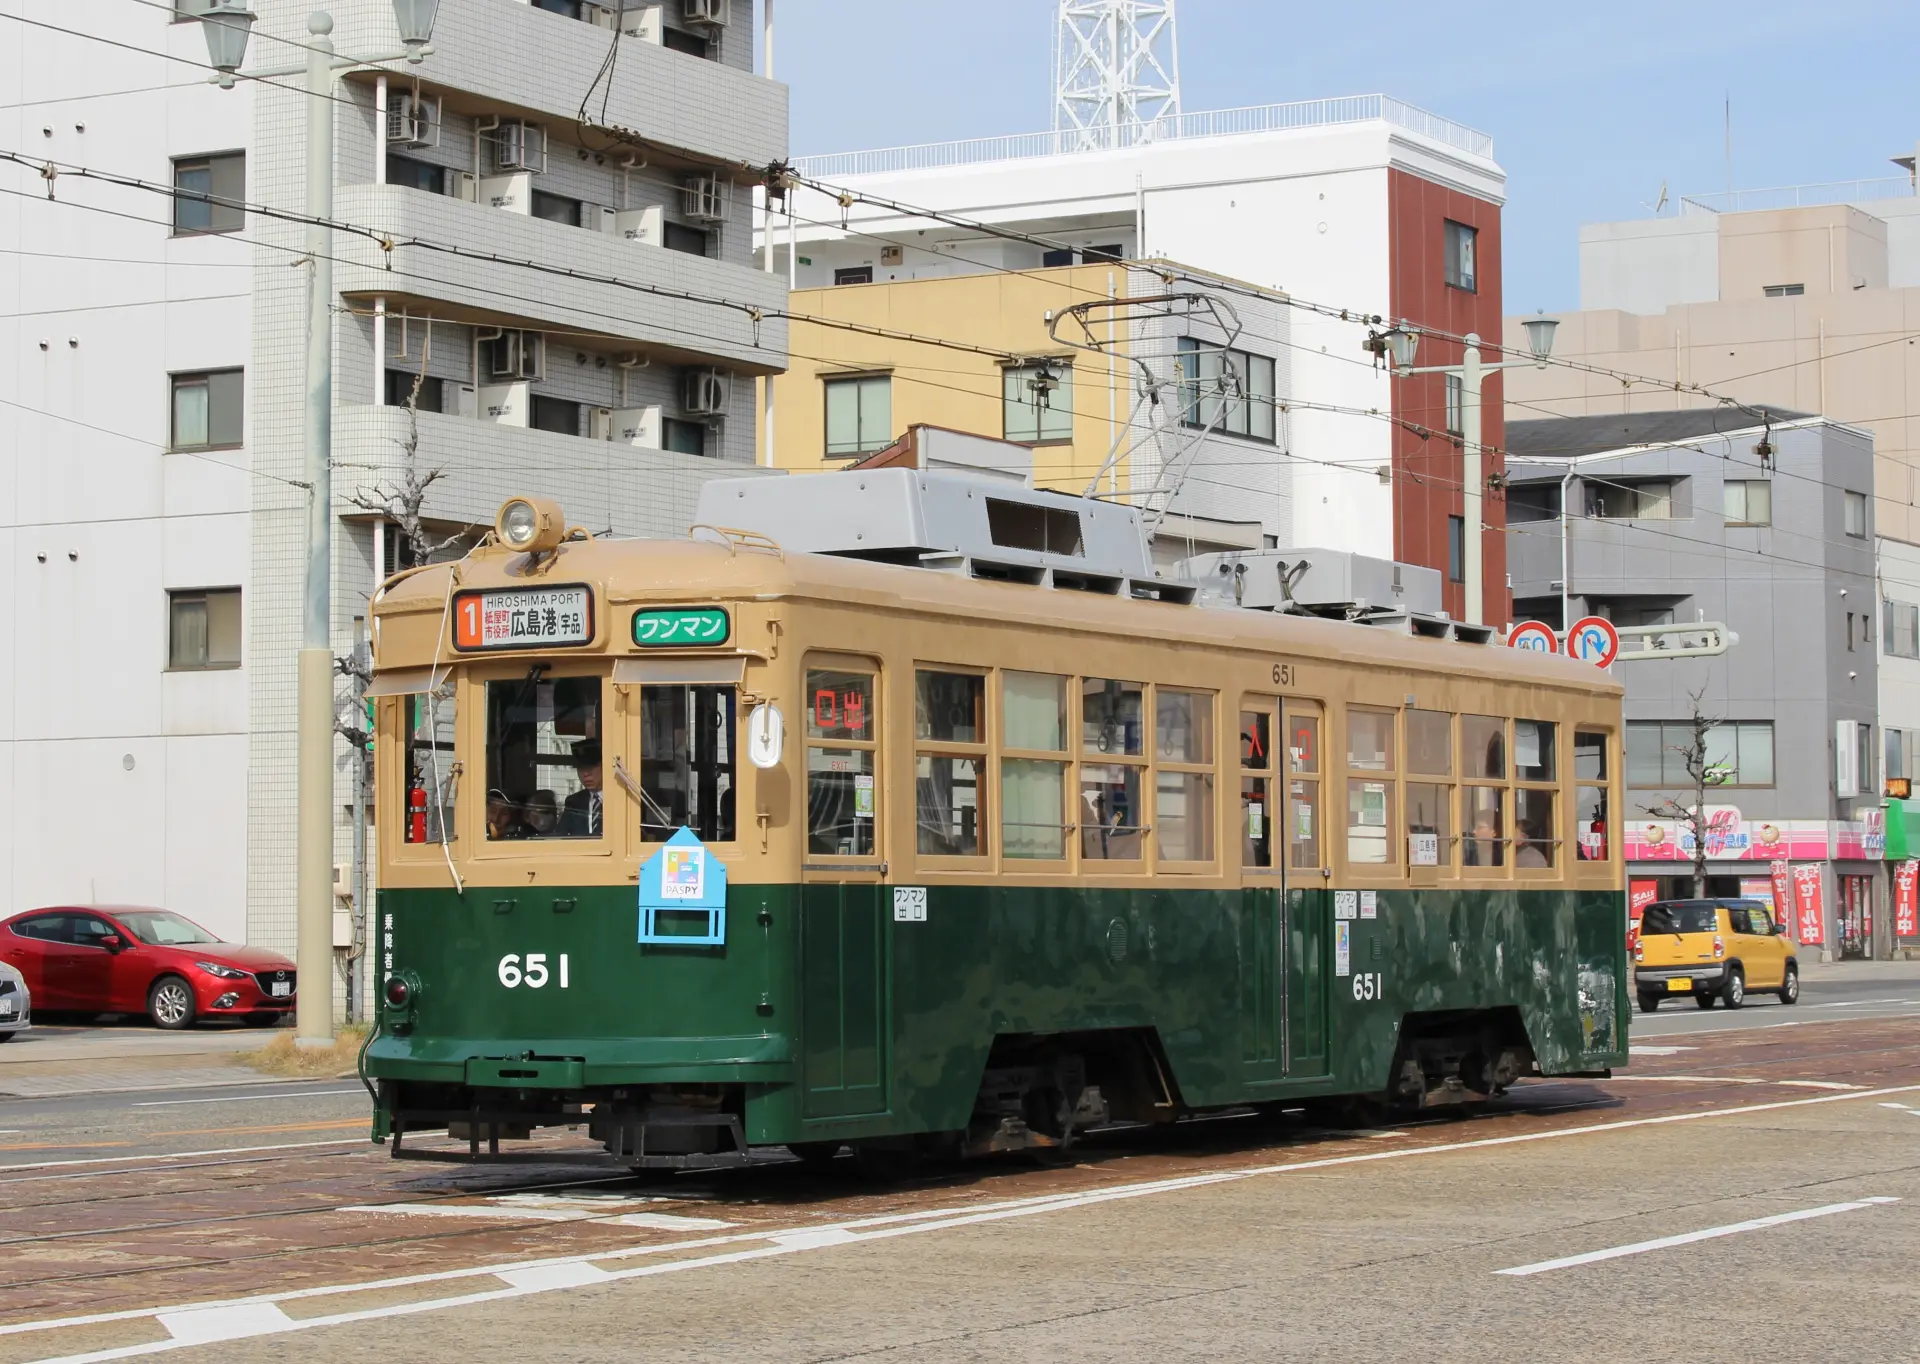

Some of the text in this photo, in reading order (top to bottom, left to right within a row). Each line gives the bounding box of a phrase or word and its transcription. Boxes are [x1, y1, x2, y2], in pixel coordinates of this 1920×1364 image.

[487, 593, 581, 609] HIROSHIMA PORT
[464, 602, 476, 637] 1
[484, 625, 510, 639] 市役所
[638, 617, 722, 639] ワンマン
[1272, 664, 1295, 687] 651
[831, 760, 849, 771] EXIT
[1681, 833, 1749, 849] ホイト急便
[666, 886, 698, 895] PASPY
[895, 889, 926, 903] ワンマン
[1335, 892, 1356, 904] ワンマン
[1632, 889, 1655, 902] SALE
[898, 904, 923, 919] 出口
[1897, 877, 1913, 934] セール中
[498, 953, 569, 988] 651
[1353, 972, 1382, 1001] 651
